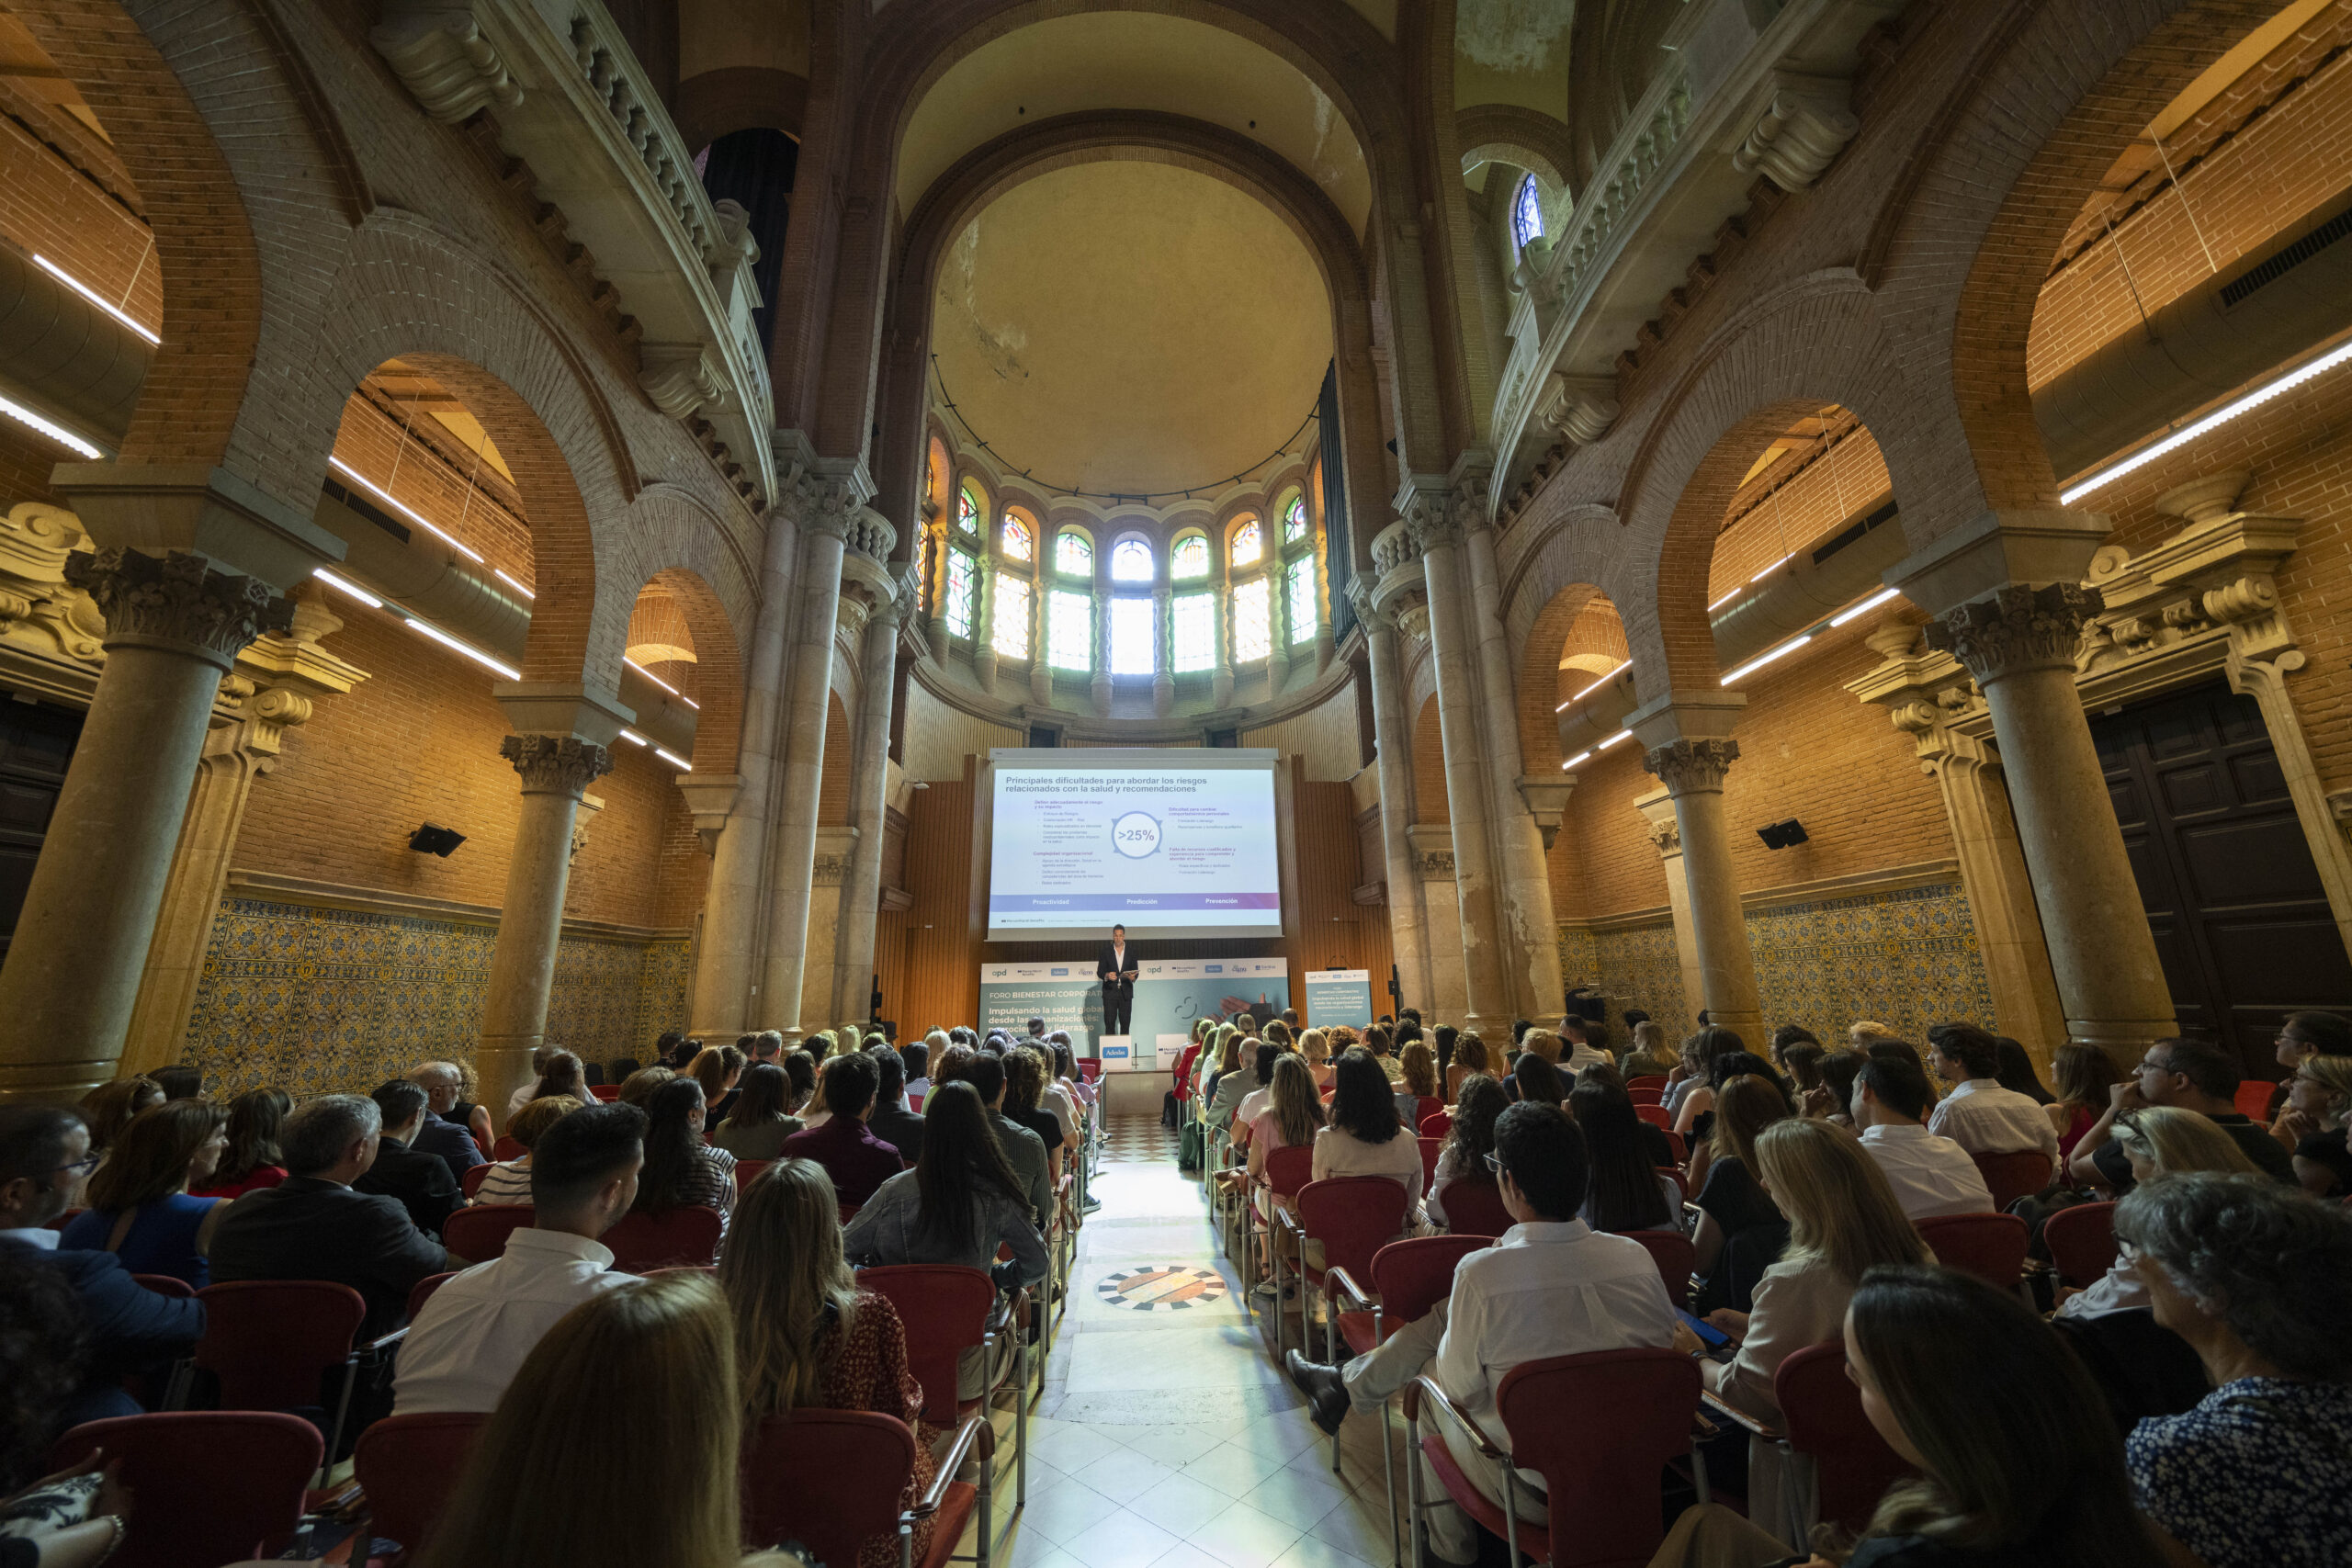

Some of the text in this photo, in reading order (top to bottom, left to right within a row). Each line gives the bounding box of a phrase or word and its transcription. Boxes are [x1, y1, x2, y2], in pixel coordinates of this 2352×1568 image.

[1006, 776, 1053, 785] Principales
[1056, 776, 1103, 784] dificultades
[1127, 776, 1159, 784] abordar
[1161, 776, 1174, 784] los
[1176, 776, 1207, 785] riesgos
[1006, 784, 1060, 793] relacionados
[1080, 784, 1088, 793] la
[1090, 784, 1113, 793] salud
[1115, 786, 1121, 795] y
[1123, 784, 1196, 793] recomendaciones
[1118, 829, 1155, 841] >25%
[992, 969, 1007, 977] apd
[1147, 965, 1162, 974] apd
[1057, 989, 1102, 998] CORPORATI
[989, 1005, 1104, 1016] Impulsando la salud global
[988, 1016, 1015, 1024] desde
[1043, 1014, 1099, 1023] anizaciones:
[1054, 1024, 1094, 1032] liderazgo
